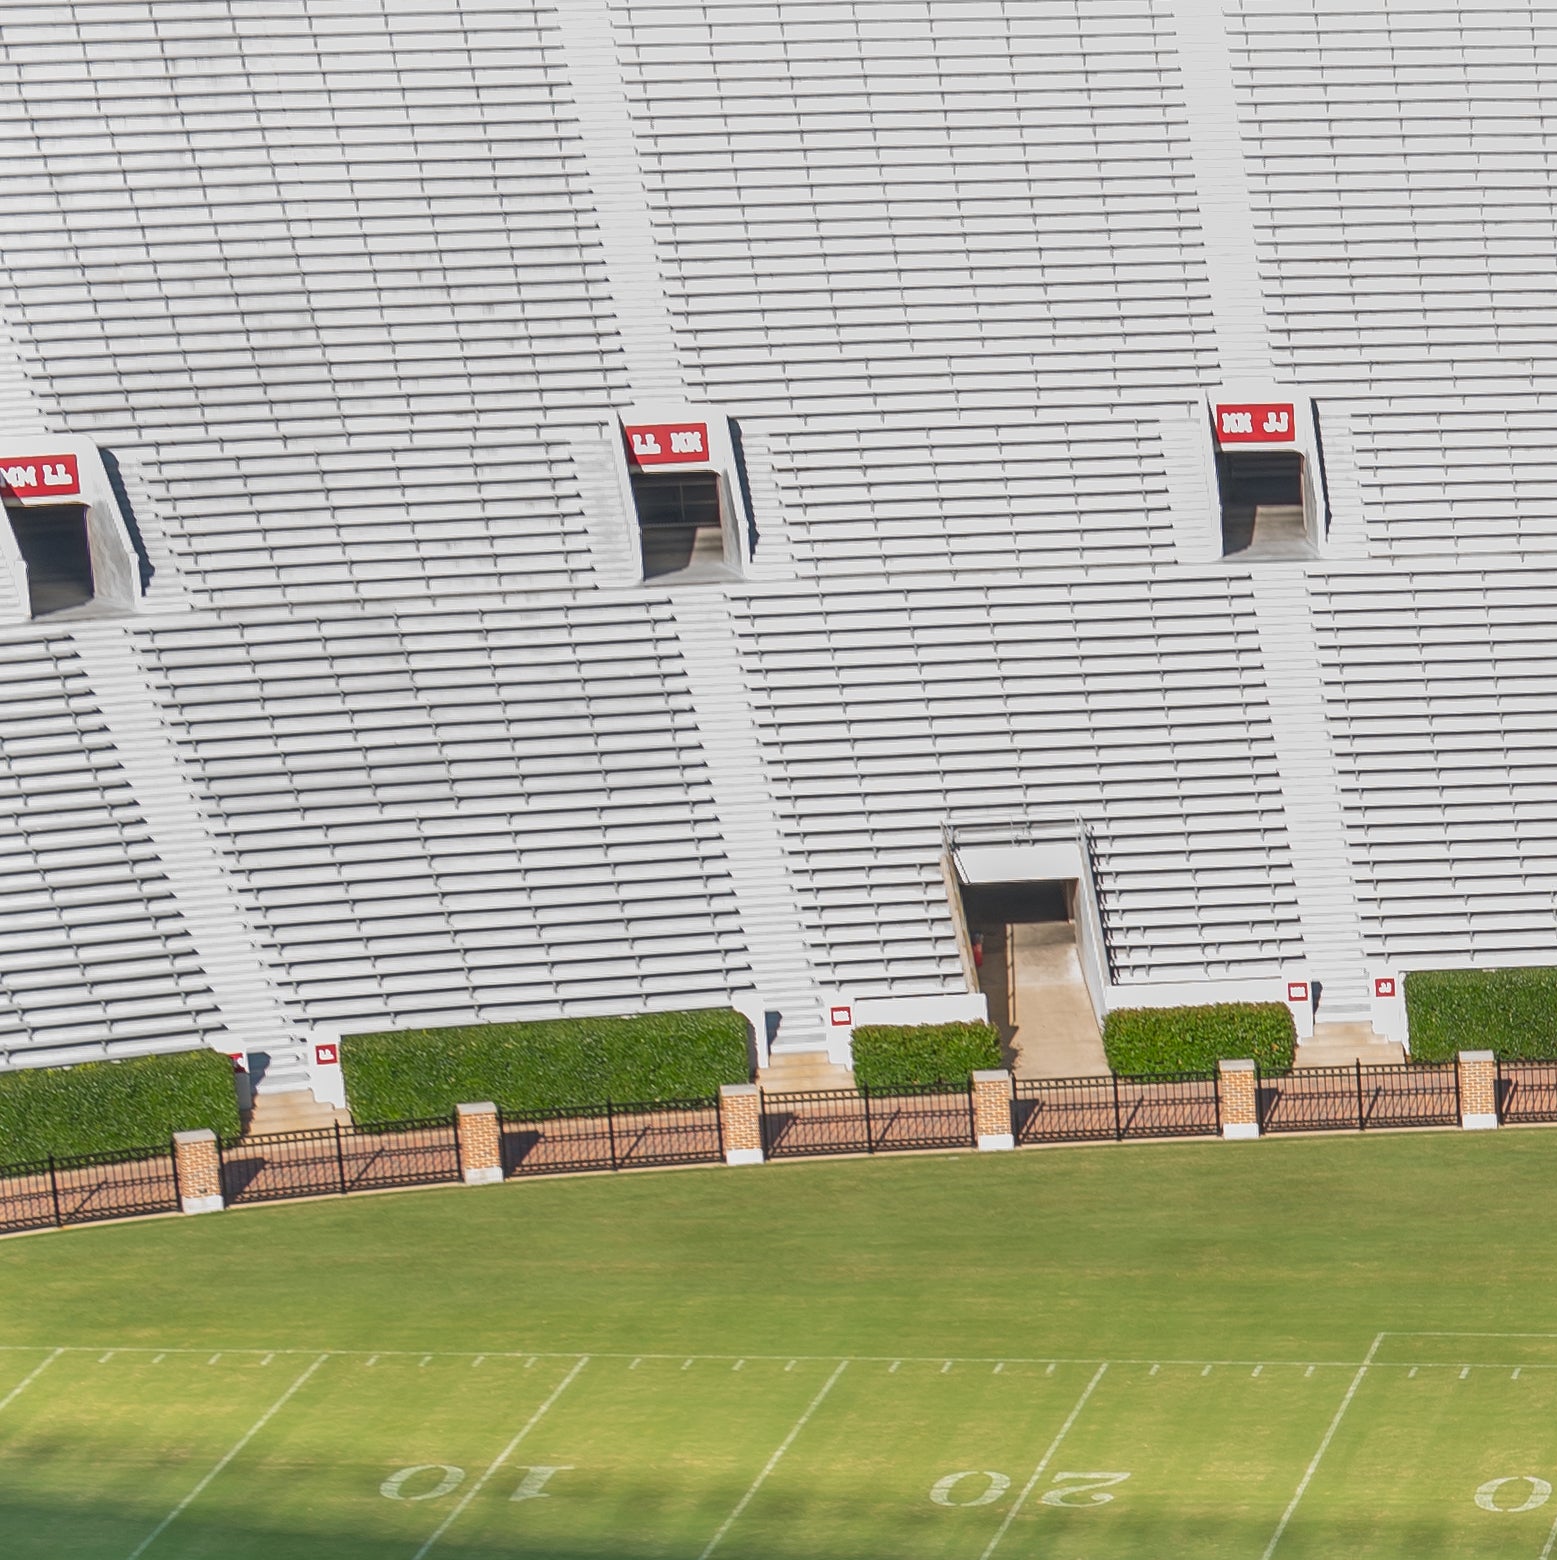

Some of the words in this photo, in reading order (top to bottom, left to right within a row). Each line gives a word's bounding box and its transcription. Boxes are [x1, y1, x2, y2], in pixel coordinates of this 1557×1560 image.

[1262, 411, 1289, 433] JJ
[631, 433, 662, 456] LL
[42, 463, 73, 486] LL
